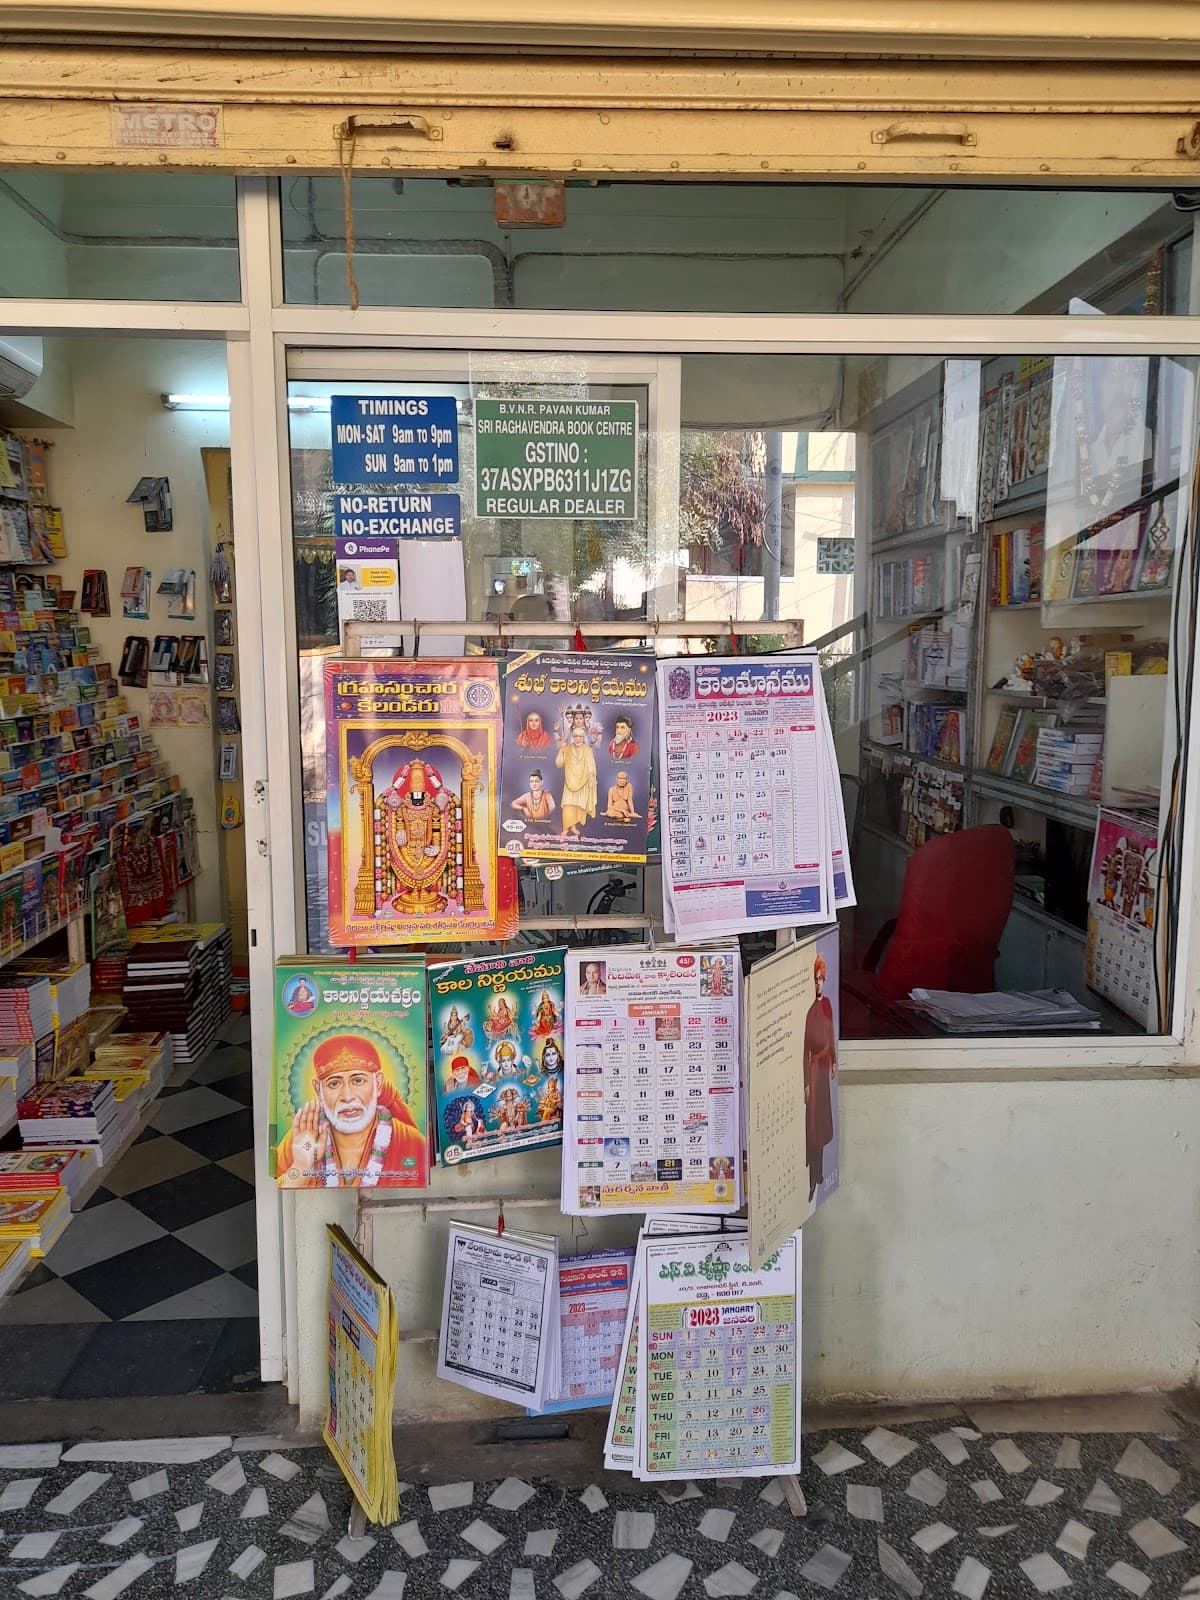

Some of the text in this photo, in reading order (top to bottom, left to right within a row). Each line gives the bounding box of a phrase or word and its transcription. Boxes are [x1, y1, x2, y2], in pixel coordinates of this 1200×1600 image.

[119, 113, 216, 131] METRO
[359, 400, 428, 415] TIMINGS
[500, 405, 610, 415] B.V.N.R. PAVAN KUMAR
[478, 421, 632, 435] SRI RAGHAVENDRA BOOK CENTRE
[337, 425, 452, 447] MON-SAT 9am TO 9pm
[366, 454, 452, 476] SUN 9am TO 1pm
[482, 469, 631, 492] 37ASXPB6311J1ZG
[341, 498, 431, 513] NO-RETURN
[487, 499, 625, 514] REGULAR DEALER
[342, 518, 453, 535] NO-EXCHANGE
[707, 712, 738, 722] 2023
[437, 979, 472, 993] కాల
[478, 964, 561, 992] నిర్ణయము
[733, 1263, 752, 1272] అం
[482, 1277, 498, 1286] 2023
[569, 1303, 585, 1313] 2023
[690, 1306, 754, 1326] 2023 JANUARY
[652, 1332, 673, 1341] SUN
[776, 1324, 788, 1333] 29
[651, 1352, 674, 1360] MON
[653, 1372, 672, 1380] TUE
[652, 1392, 674, 1401] WED
